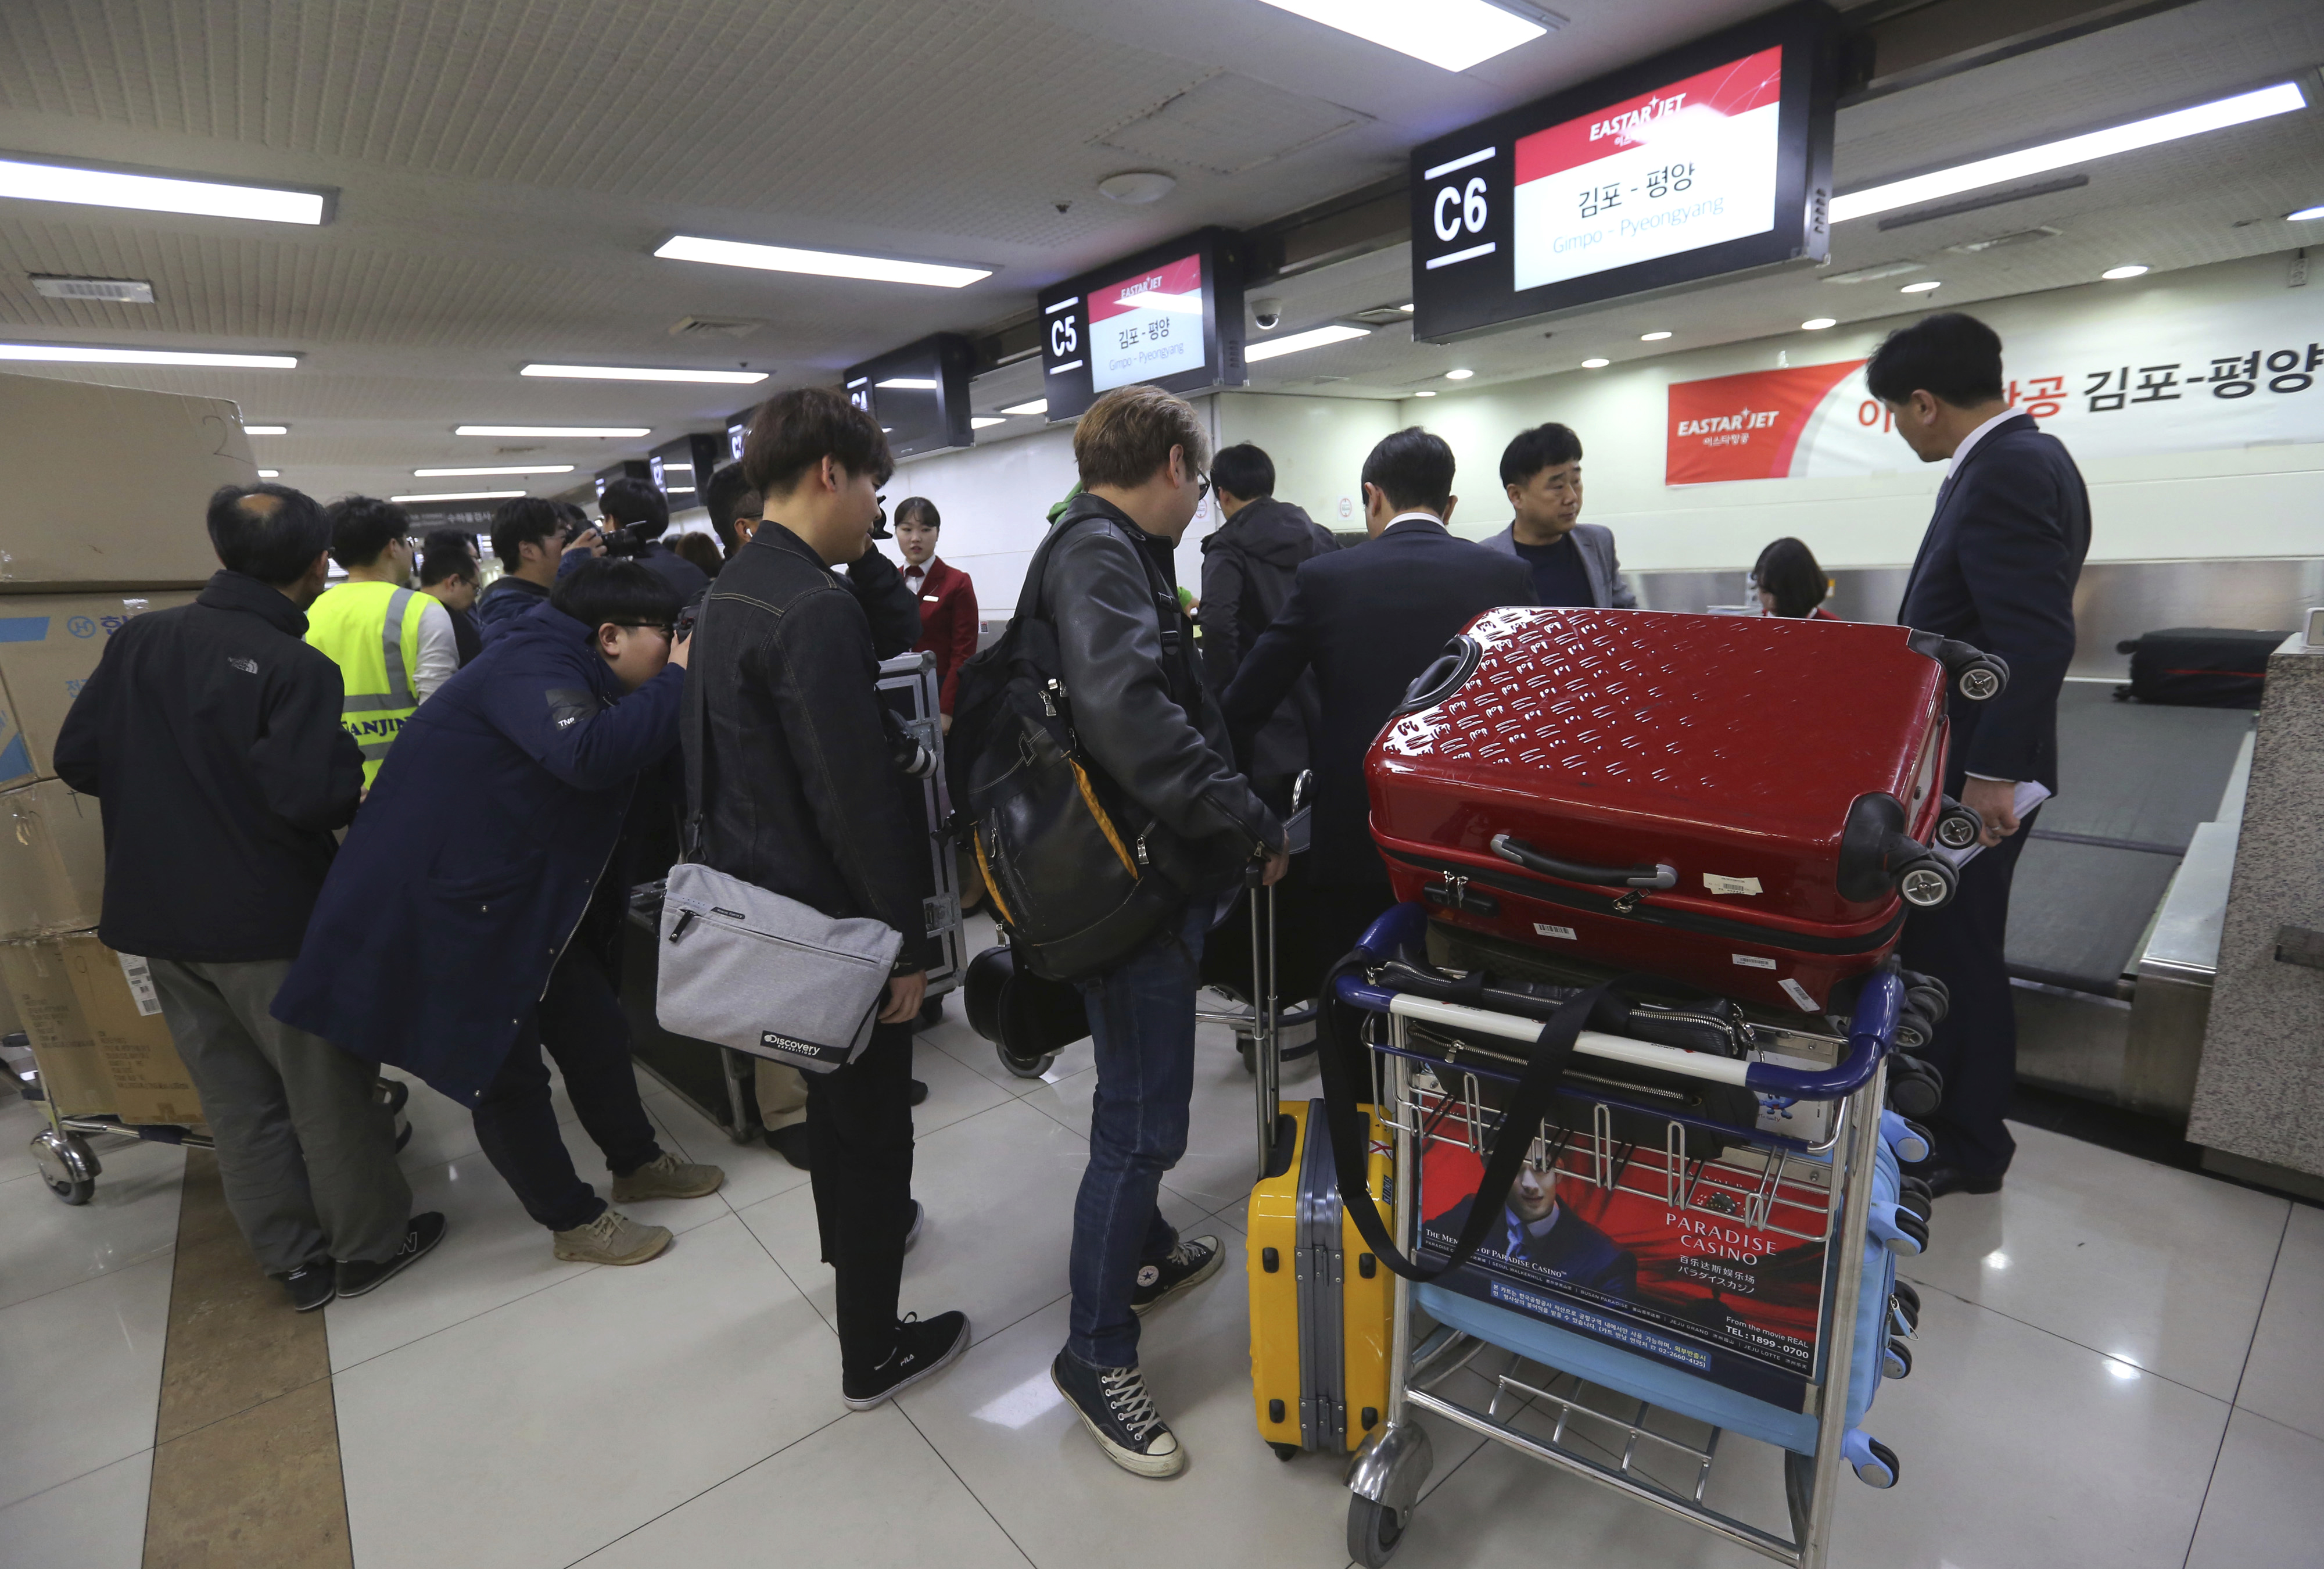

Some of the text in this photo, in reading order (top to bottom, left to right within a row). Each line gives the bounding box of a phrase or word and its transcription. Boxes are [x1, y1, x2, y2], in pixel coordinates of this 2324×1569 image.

[1589, 105, 1651, 142] EASTAR
[1655, 92, 1687, 119] JET
[1579, 182, 1622, 218] 김포
[1647, 161, 1696, 198] 평양
[1434, 177, 1488, 242] C6
[1554, 230, 1602, 253] Gimpo
[1620, 197, 1724, 237] Pyeongyang
[1120, 275, 1163, 299] EASTAR JET
[1052, 316, 1077, 357] C5
[1118, 328, 1139, 350] 김포
[1149, 317, 1170, 341] 평양
[1109, 356, 1132, 371] Gimpo
[1139, 342, 1184, 364] Pyeongyang
[2084, 343, 2324, 413] 김포-평양
[1677, 411, 1780, 437] EASTAR JET
[1703, 433, 1750, 446] 이스타항공
[341, 716, 410, 736] ANJIN
[764, 1034, 820, 1055] Discovery
[777, 1044, 812, 1055] EXPEDITION
[1425, 1240, 1450, 1252] PARADISE
[1426, 1229, 1440, 1240] THE
[1481, 1248, 1491, 1256] OF
[1492, 1250, 1530, 1268] PARADISE
[1666, 1213, 1777, 1255] PARADISE
[1680, 1235, 1758, 1265] CASINO
[1492, 1262, 1543, 1281] SEOUL WALKERHILL
[1678, 1266, 1755, 1294] パラダイスカジノ
[1680, 1255, 1755, 1284] 百乐达斯娱乐场
[1580, 1290, 1628, 1309] BUSAN PARADISE
[1501, 1287, 1518, 1297] 카트는
[1519, 1292, 1552, 1308] 한국공항공사
[1579, 1313, 1602, 1326] 공항구역
[1604, 1321, 1629, 1334] 내에서만
[1630, 1330, 1643, 1340] 사용
[1645, 1336, 1672, 1350] 가능하며,
[1670, 1319, 1709, 1335] JEJU GRAND
[1726, 1316, 1809, 1348] From the movie REAL
[1572, 1317, 1597, 1330] 있습니다.
[1630, 1337, 1648, 1349] 연락처
[1659, 1347, 1706, 1368] 02-2660-4125)
[1744, 1345, 1781, 1360] JEJU LOTTE
[1751, 1334, 1776, 1348] 1899
[1783, 1345, 1809, 1359] 0700
